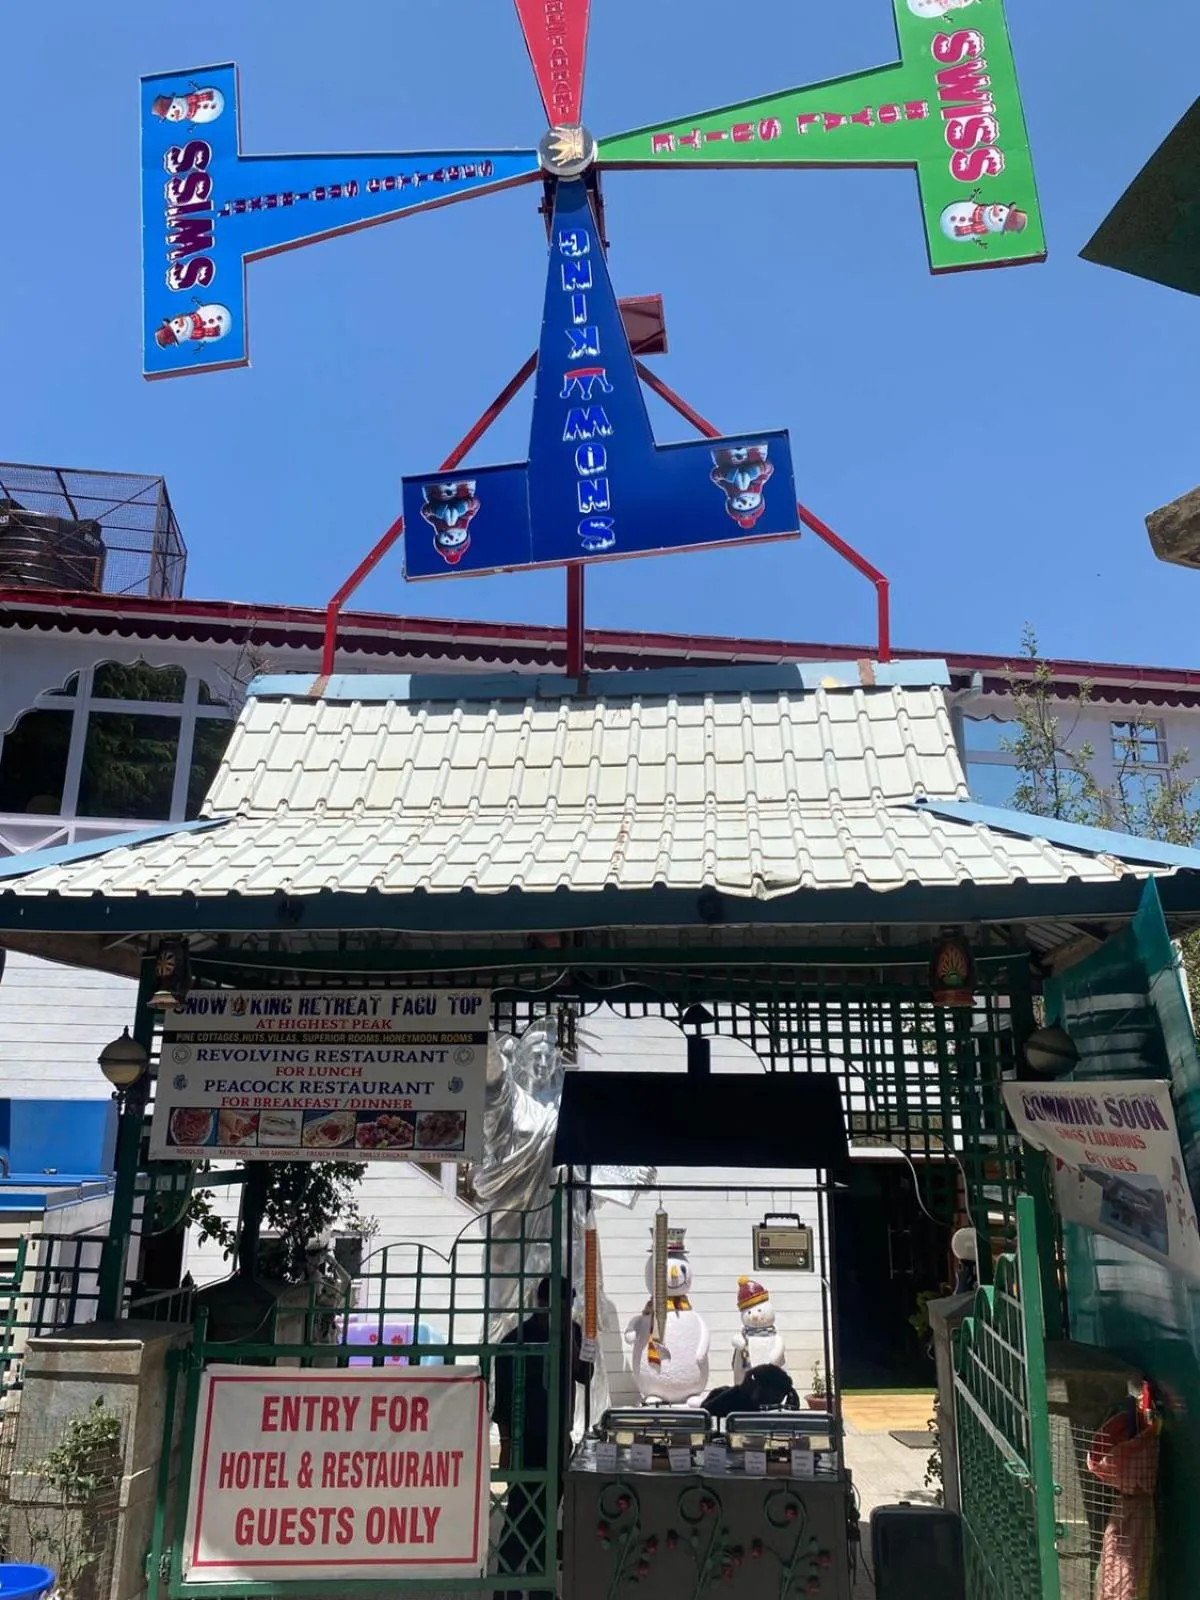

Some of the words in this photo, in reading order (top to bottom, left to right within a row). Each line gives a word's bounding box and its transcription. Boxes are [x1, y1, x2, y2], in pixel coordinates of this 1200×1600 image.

[796, 99, 929, 136] ROYAL
[931, 28, 1006, 183] SWISS
[651, 117, 783, 154] SUITE
[217, 180, 359, 218] LUXURIOUS
[366, 159, 494, 194] COTTAGES
[164, 140, 216, 292] SWISS
[558, 228, 601, 360] KING
[562, 405, 616, 550] SNOW
[250, 992, 293, 1016] KING
[298, 993, 382, 1016] RETREAT
[391, 993, 437, 1016] FAGU
[447, 993, 483, 1016] TOP
[176, 1033, 195, 1042] PINE
[302, 1033, 346, 1043] SUPERIOR
[383, 1033, 439, 1043] HONEYMOON
[441, 1034, 473, 1043] ROOMS
[256, 1019, 274, 1030] AT
[278, 1019, 349, 1030] HIGHEST
[352, 1019, 392, 1030] PEAK
[197, 1049, 309, 1063] REVOLVING
[315, 1050, 449, 1063] RESTAURANT
[275, 1066, 305, 1076] FOR
[308, 1066, 363, 1077] LUNCH
[204, 1080, 294, 1093] PEACOCK
[300, 1081, 434, 1095] RESTAURANT
[221, 1097, 249, 1107] FOR
[253, 1098, 341, 1108] BREAKFAST
[1021, 1092, 1104, 1126] COMMING
[1102, 1092, 1169, 1131] SOON
[261, 1396, 361, 1433] ENTRY
[370, 1396, 429, 1433] FOR
[219, 1452, 289, 1489] HOTEL
[297, 1451, 313, 1489] &
[321, 1451, 464, 1488] RESTAURANT
[235, 1507, 354, 1545] GUESTS
[365, 1506, 442, 1545] ONLY
